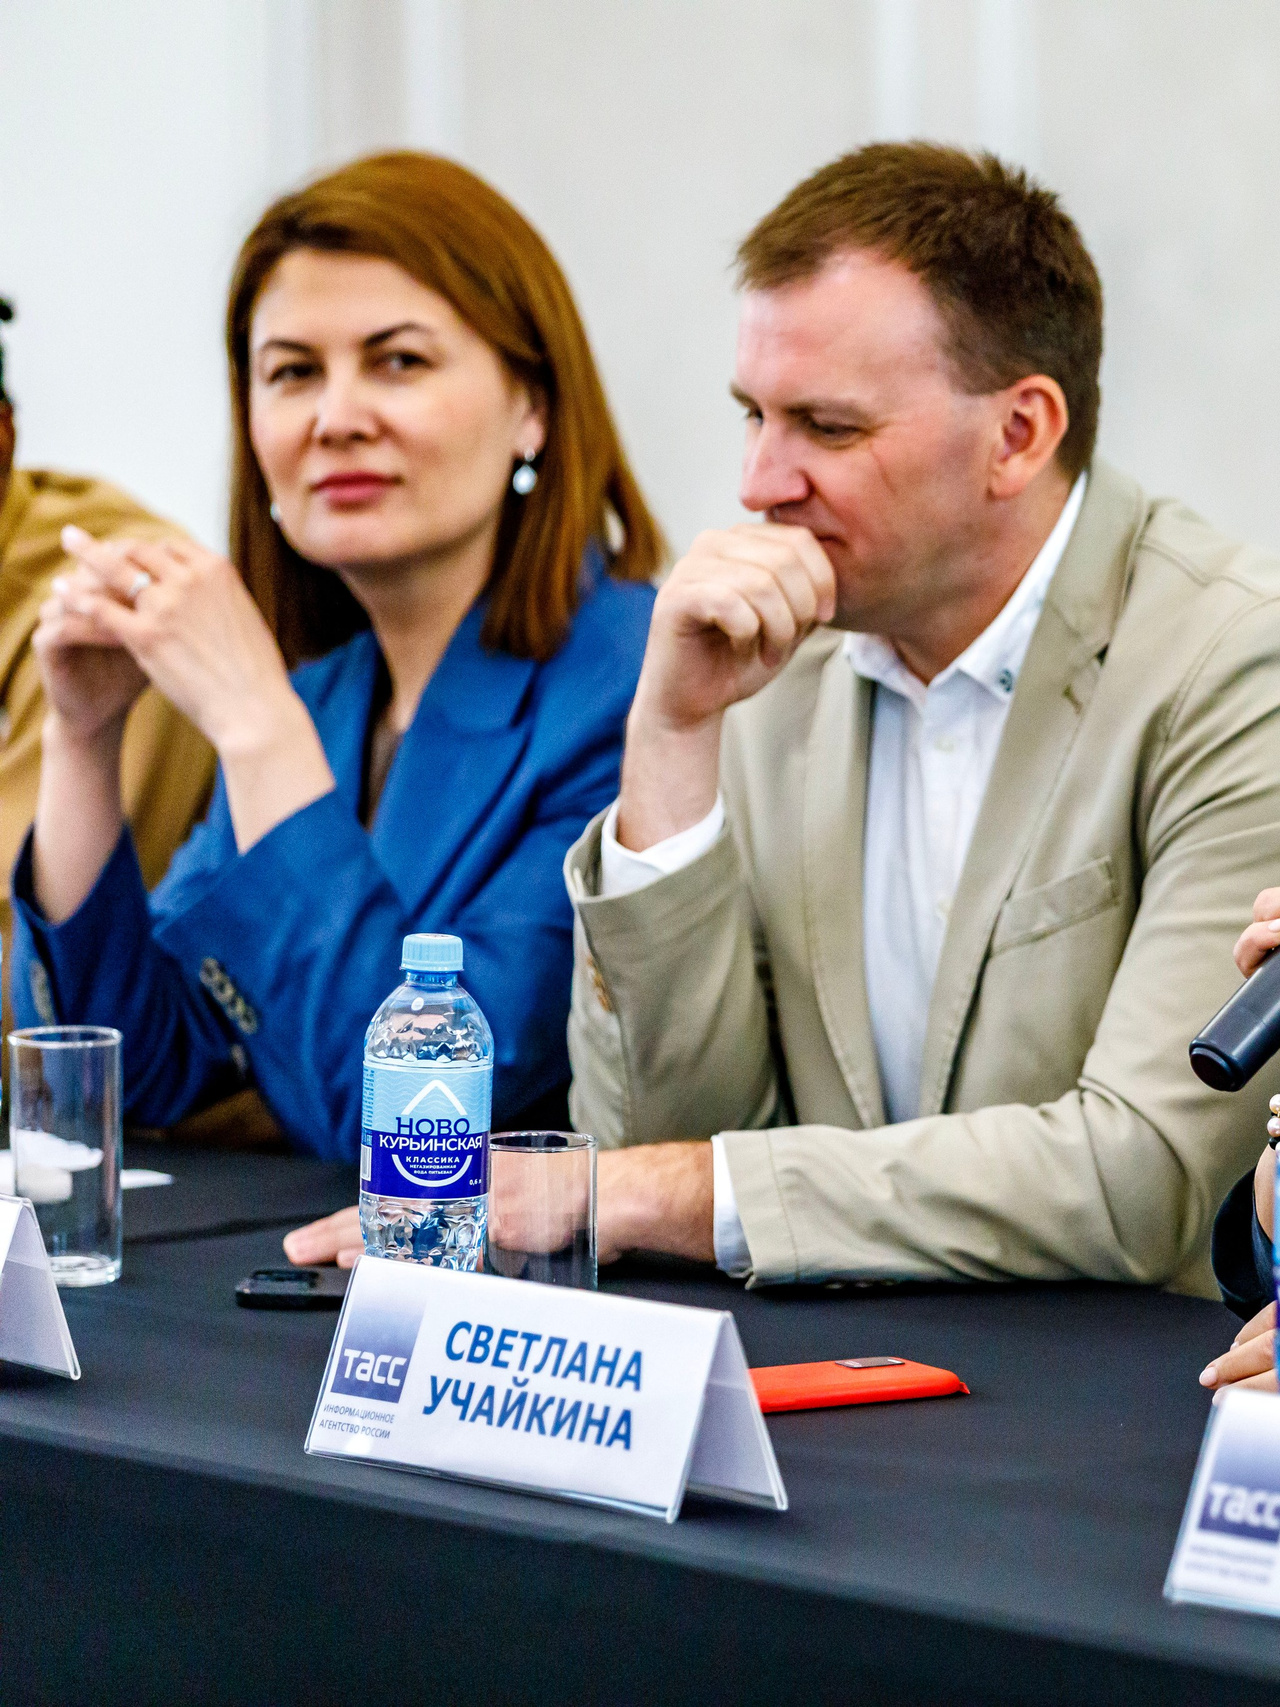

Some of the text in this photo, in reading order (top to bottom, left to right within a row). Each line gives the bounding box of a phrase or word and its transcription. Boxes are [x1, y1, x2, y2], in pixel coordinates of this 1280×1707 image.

[395, 1116, 470, 1137] НОВО
[379, 1134, 483, 1152] КУРЬИНСКАЯ
[405, 1155, 460, 1164] КЛАССИКА
[445, 1321, 643, 1393] СВЕТЛАНА
[323, 1403, 396, 1424] ИНФОРМАЦИОННОЕ
[422, 1375, 633, 1451] УЧАЙКИНА
[319, 1418, 391, 1440] АГЕНТСТВО РОССИИ
